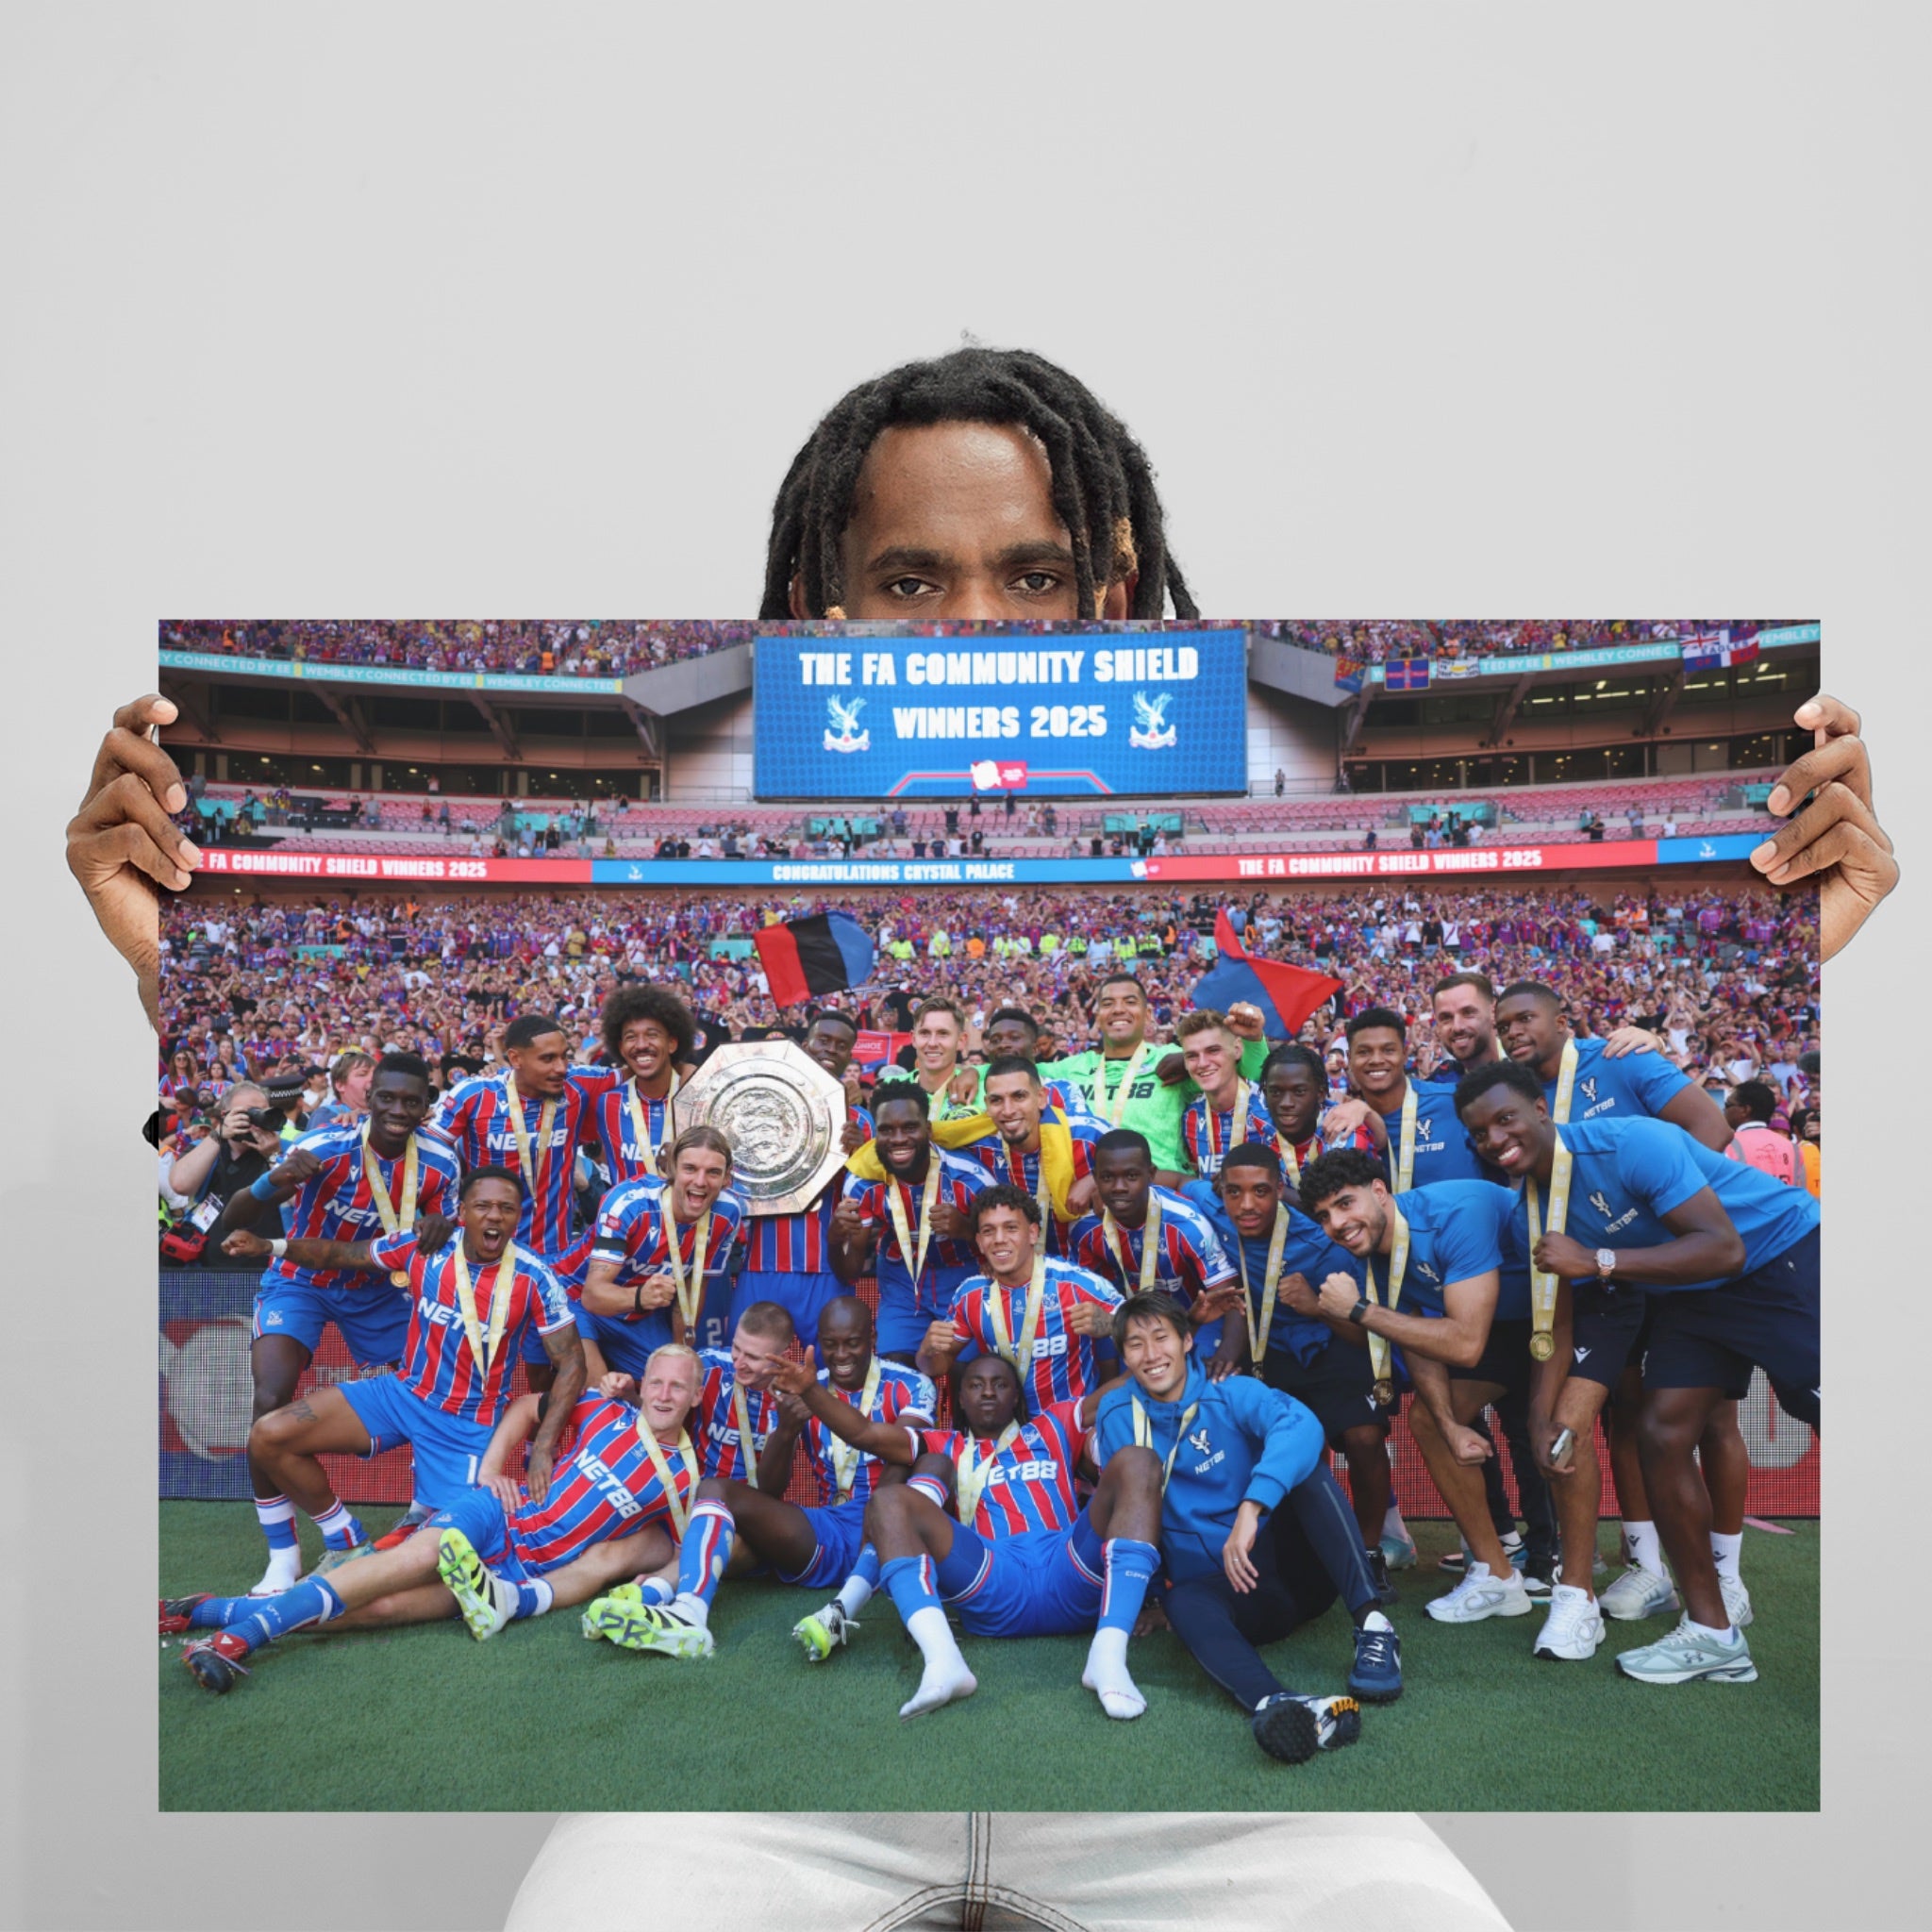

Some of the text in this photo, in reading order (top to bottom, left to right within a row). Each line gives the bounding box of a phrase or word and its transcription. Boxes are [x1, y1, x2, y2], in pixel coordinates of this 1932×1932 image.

[175, 654, 256, 672] CONNECTED
[258, 662, 274, 673] BY
[276, 663, 291, 674] EE
[799, 646, 1199, 685] THE FA COMMUNITY SHIELD
[1510, 659, 1524, 670] BY
[1525, 658, 1540, 669] EE
[1557, 644, 1679, 665] WEMBLEY CONNECT
[305, 665, 363, 679] WEMBLEY
[366, 670, 441, 683] CONNECTED
[443, 674, 458, 684] BY
[487, 676, 614, 691] WEMBLEY CONNECTED
[892, 705, 1108, 739] WINNERS 2025
[209, 853, 227, 870] FA
[232, 855, 322, 874] COMMUNITY
[326, 858, 377, 874] SHIELD
[381, 859, 444, 876] WINNERS
[448, 861, 487, 877] 2025
[773, 863, 1014, 880] CONGRATULATIONS CRYSTAL PALACE
[1239, 850, 1542, 875] THE FA COMMUNITY SHIELD WINNERS 2025
[324, 1198, 383, 1228] NET
[574, 1447, 643, 1520] NET88
[987, 1459, 1058, 1487] ET88
